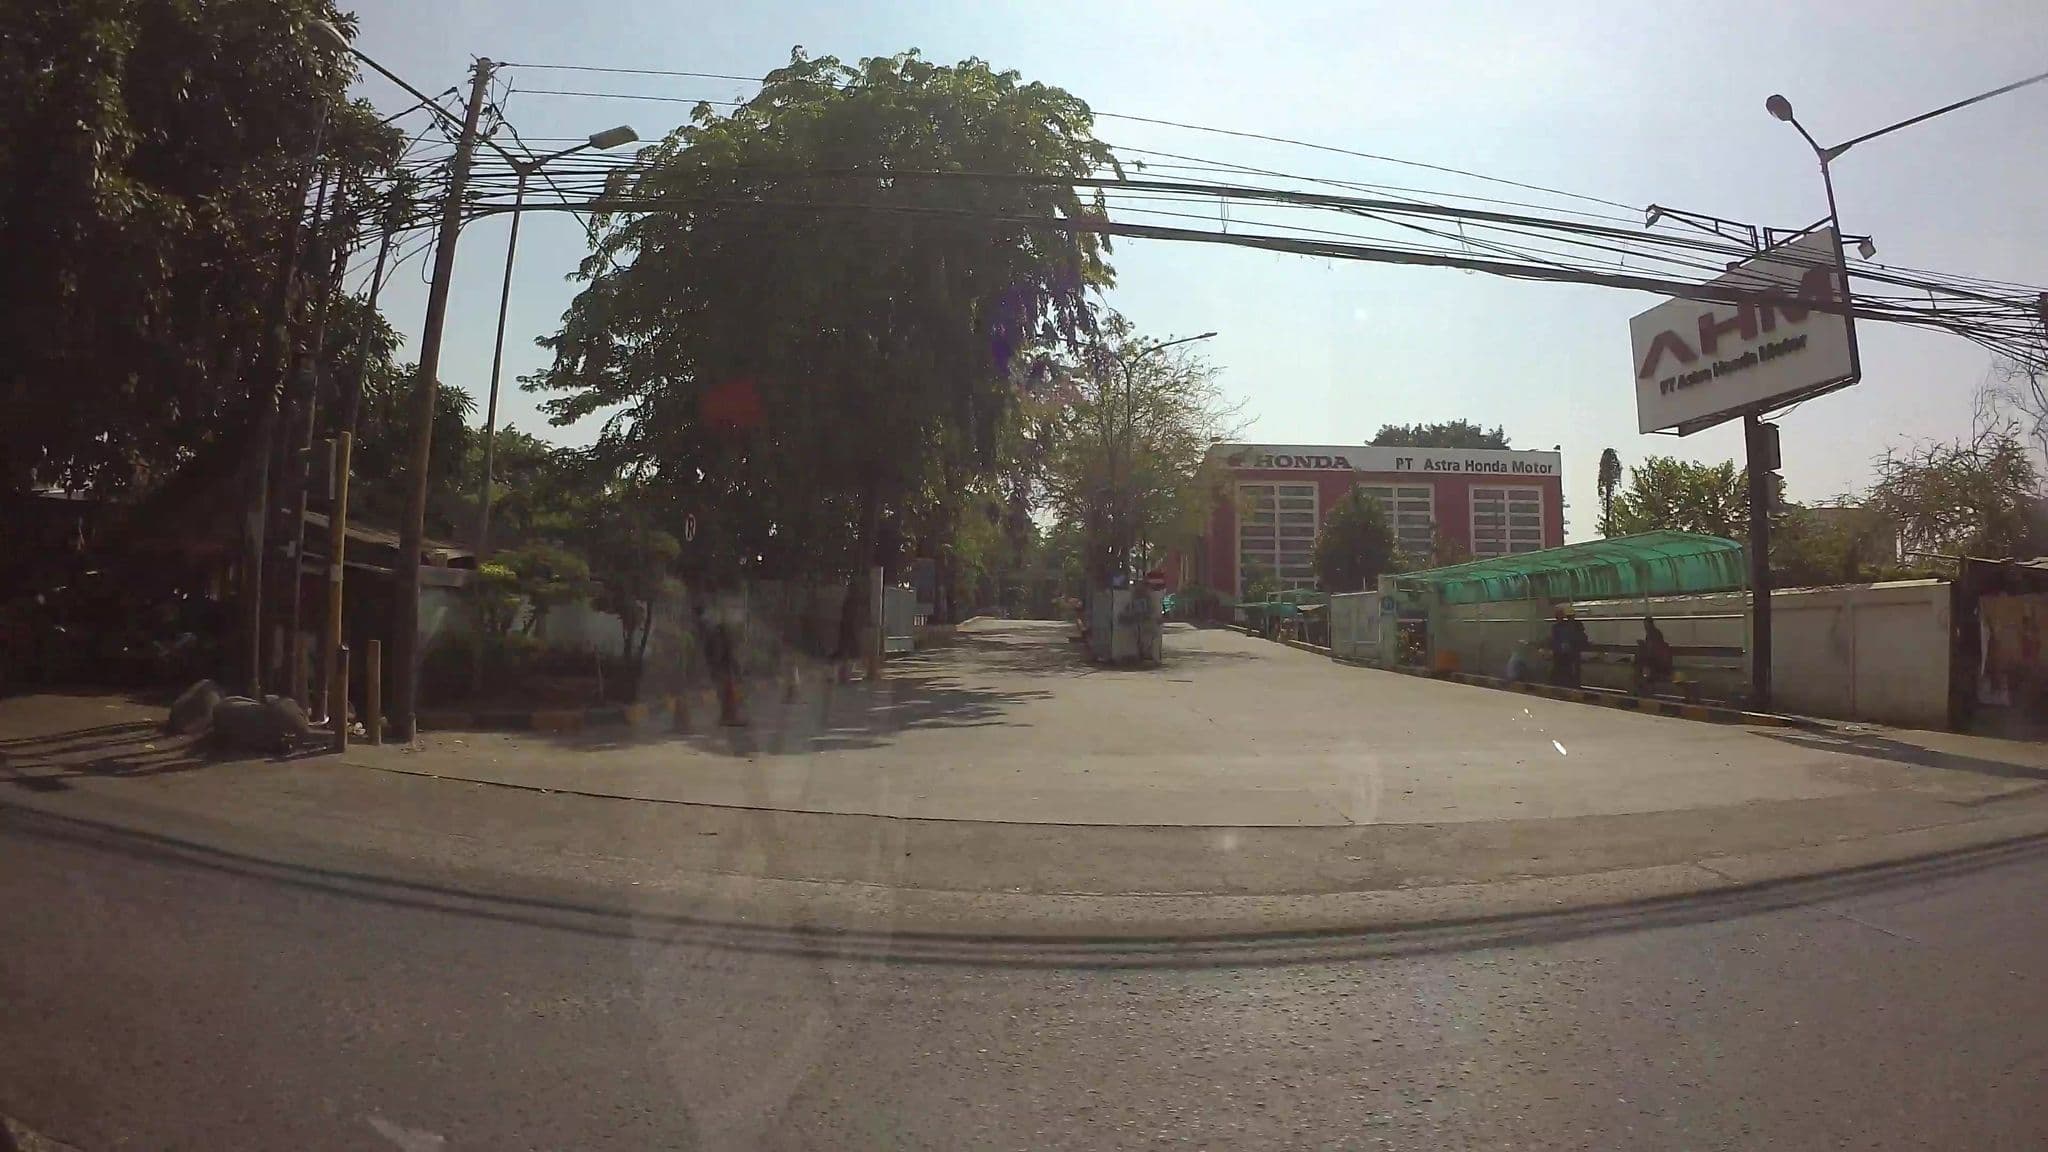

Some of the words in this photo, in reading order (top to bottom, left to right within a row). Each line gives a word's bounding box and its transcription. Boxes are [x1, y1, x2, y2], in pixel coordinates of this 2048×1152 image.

[1254, 454, 1353, 469] HONDA
[1395, 457, 1413, 470] PT
[1424, 458, 1460, 471] Astra
[1465, 459, 1507, 473] Honda
[1512, 460, 1553, 474] Motor
